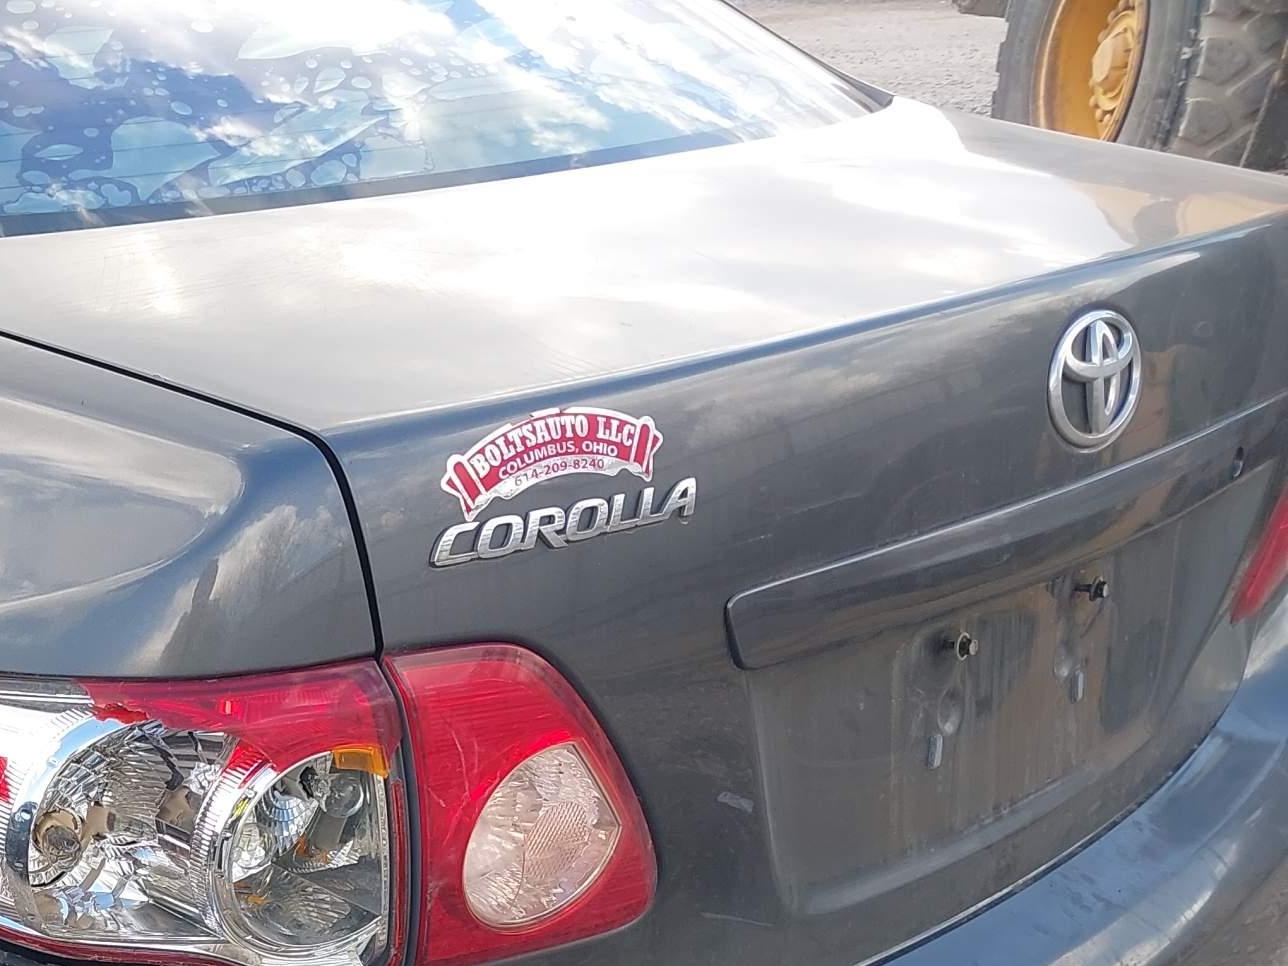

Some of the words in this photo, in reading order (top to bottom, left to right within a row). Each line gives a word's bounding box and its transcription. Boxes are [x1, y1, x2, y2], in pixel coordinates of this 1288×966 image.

[470, 415, 589, 479] BOLTSAUTO
[596, 415, 636, 446] LLC
[498, 440, 580, 480] COLUMBUS,
[582, 440, 618, 458] OHIO
[514, 457, 605, 487] 614-209-8240
[430, 477, 697, 567] COROLLA
